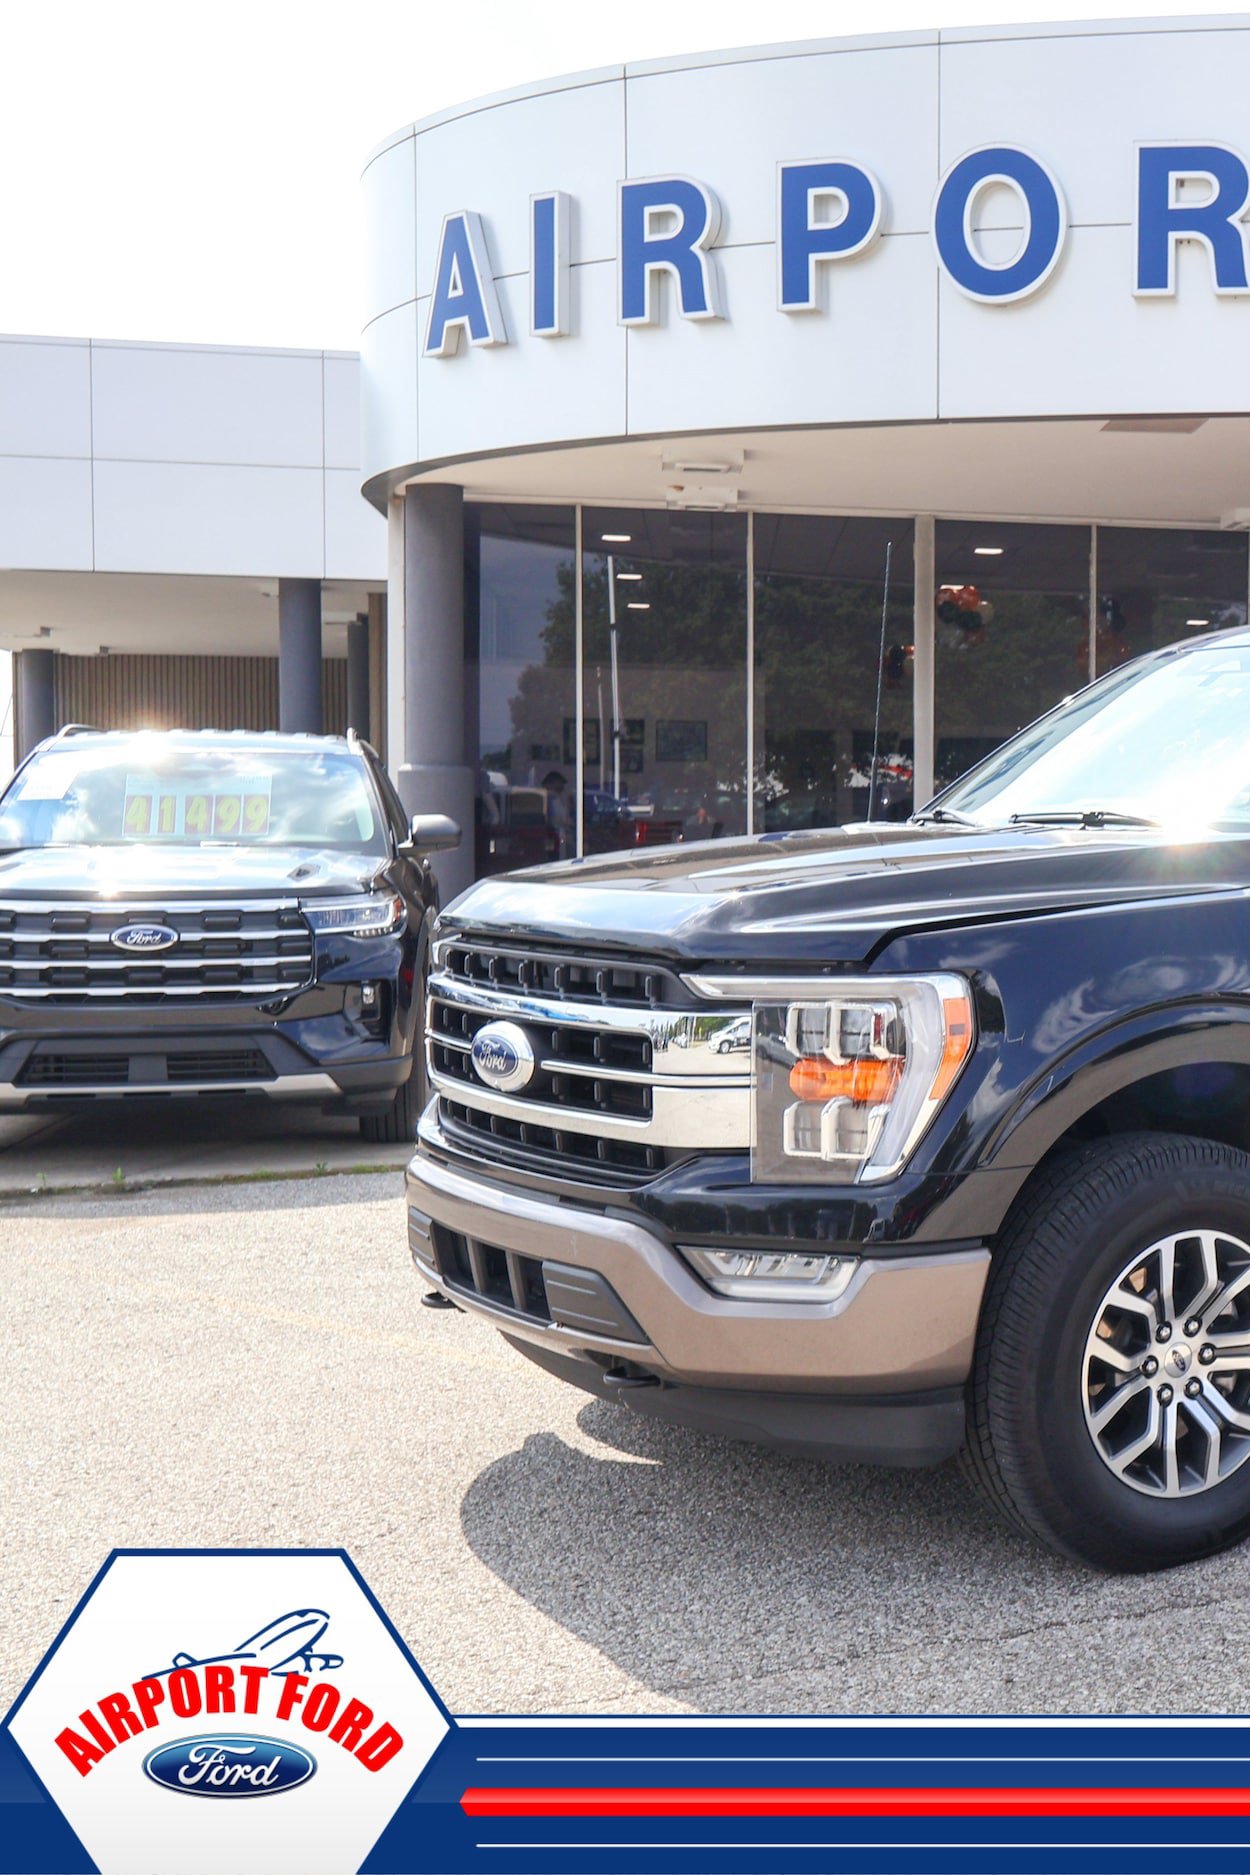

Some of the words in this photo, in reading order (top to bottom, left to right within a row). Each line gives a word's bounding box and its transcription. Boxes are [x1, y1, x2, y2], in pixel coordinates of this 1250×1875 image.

[126, 794, 268, 833] 41499
[126, 928, 162, 945] Ford
[479, 1039, 508, 1072] Ford
